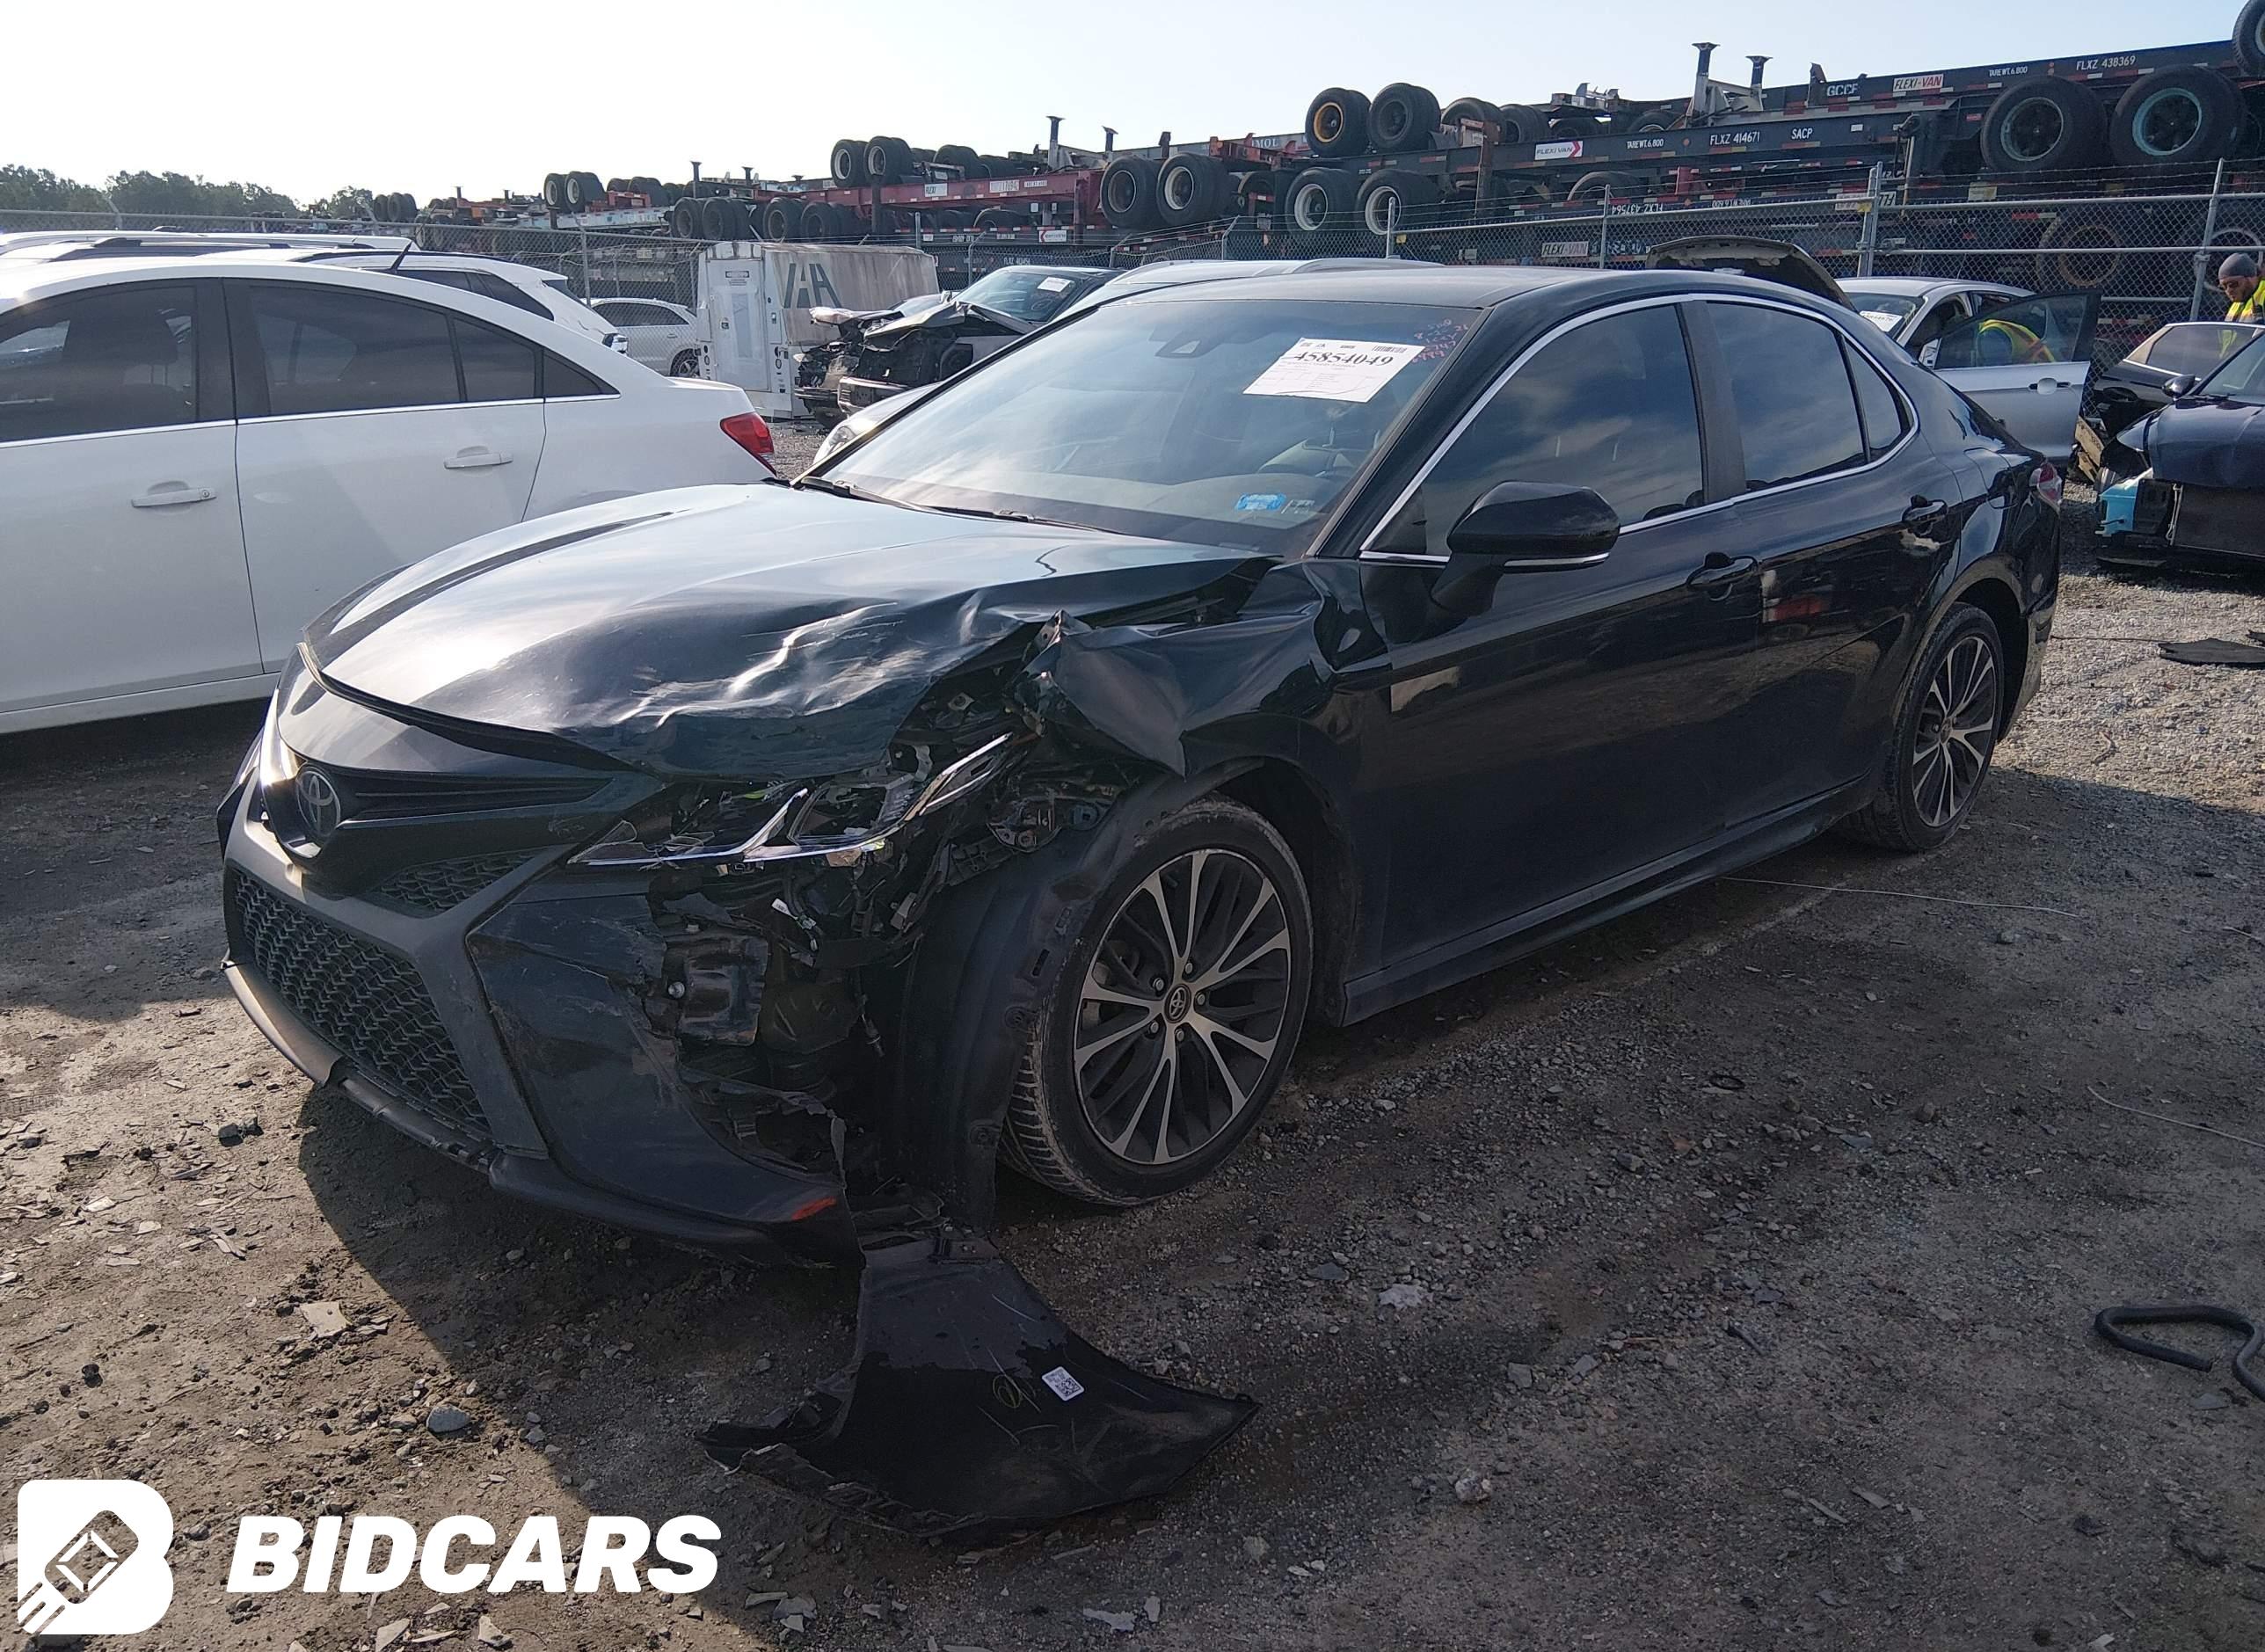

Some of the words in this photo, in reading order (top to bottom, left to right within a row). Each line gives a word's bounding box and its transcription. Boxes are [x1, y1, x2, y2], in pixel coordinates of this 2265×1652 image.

[2076, 59, 2098, 71] FLXZ
[2101, 55, 2136, 69] 438369
[1709, 134, 1730, 146] FLXZ
[1733, 131, 1760, 144] 414671
[1791, 127, 1813, 140] SACP
[1293, 351, 1394, 367] 45854049
